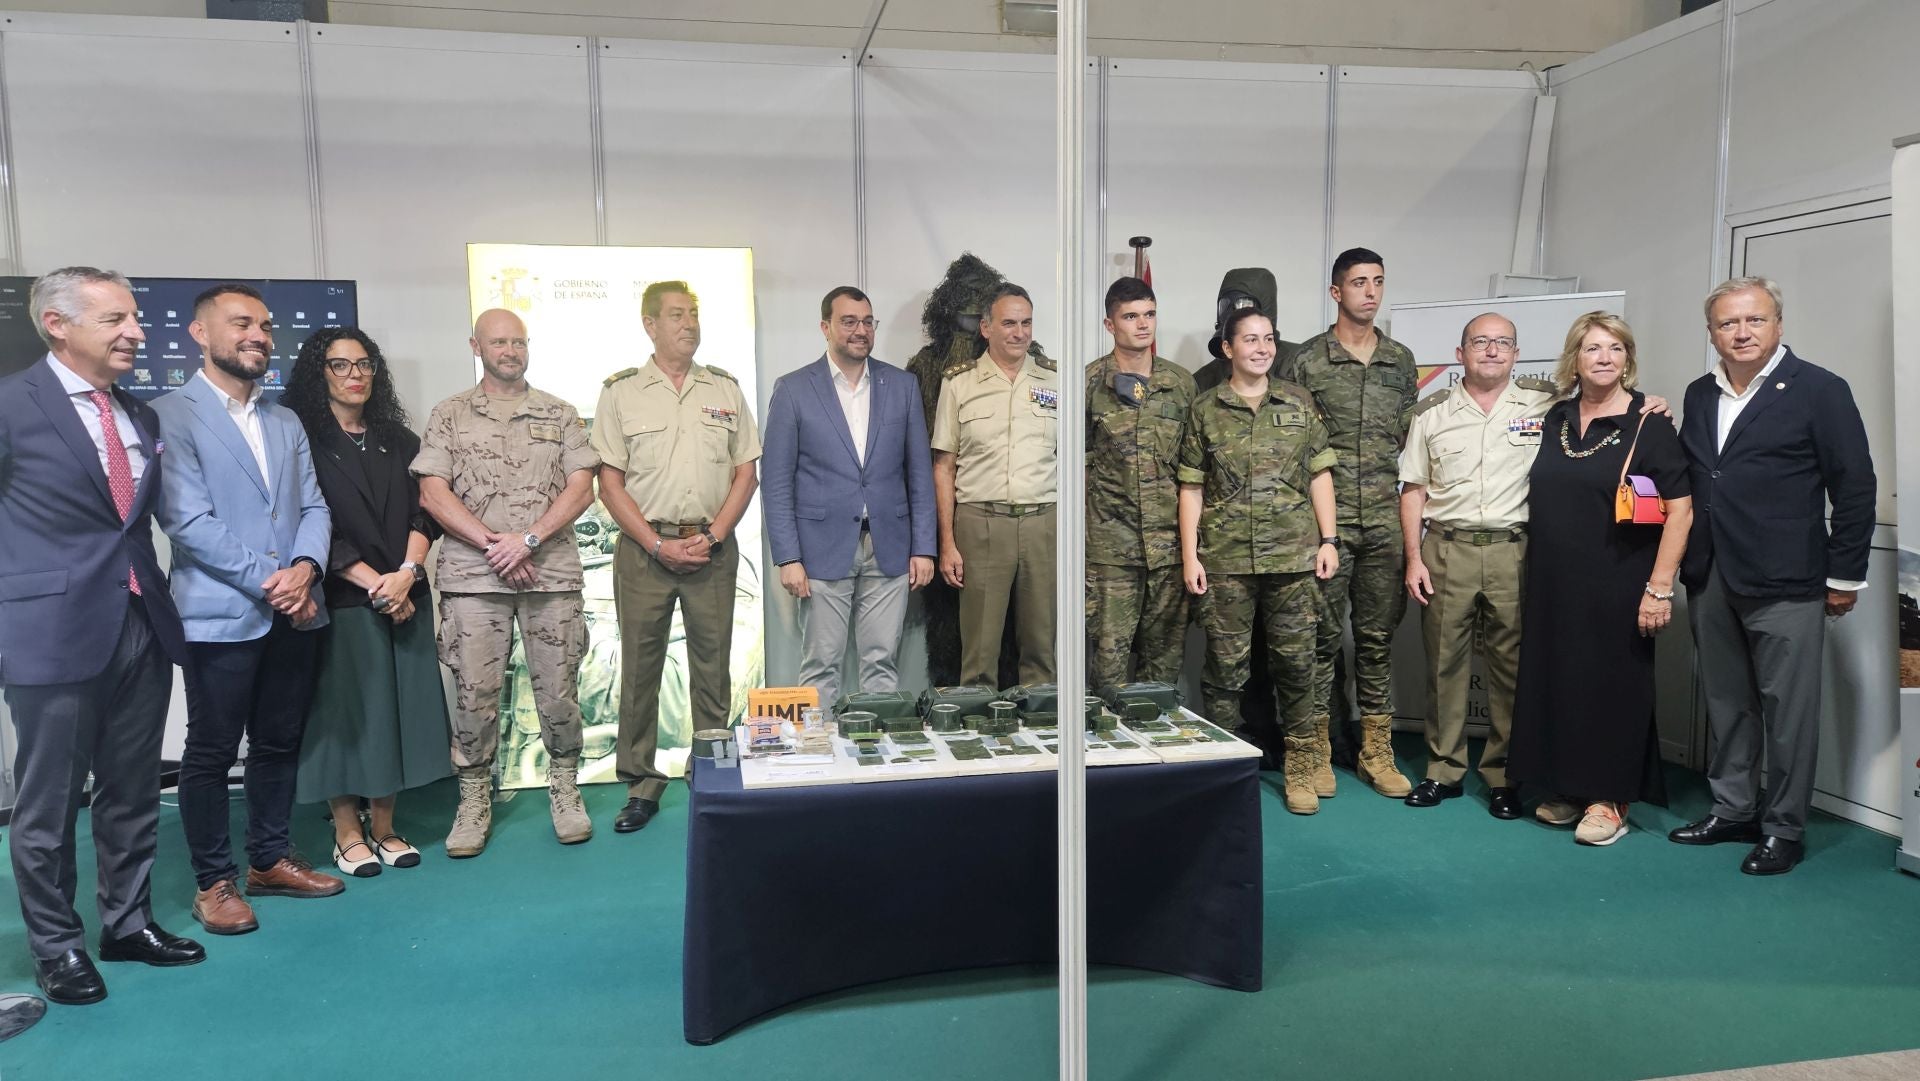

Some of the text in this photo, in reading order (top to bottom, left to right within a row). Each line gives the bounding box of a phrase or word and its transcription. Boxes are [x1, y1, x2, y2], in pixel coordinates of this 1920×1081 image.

[553, 279, 608, 288] GOBIERNO
[554, 290, 565, 299] DE
[757, 702, 811, 722] UME
